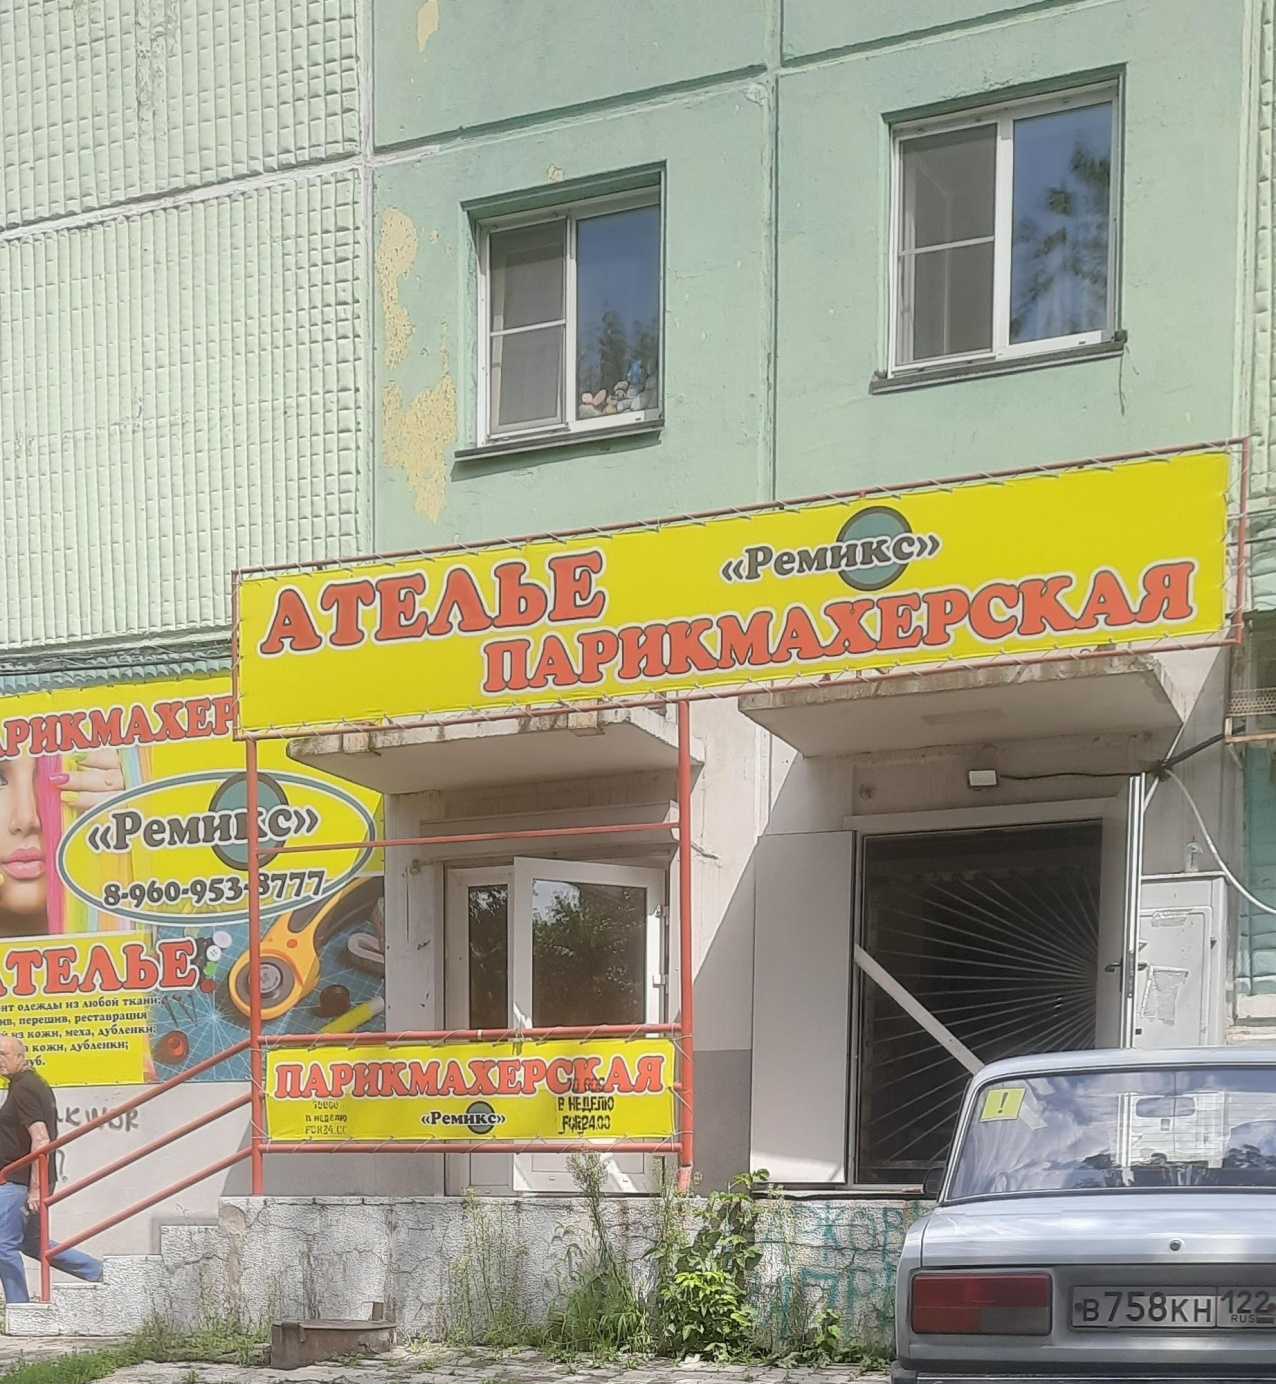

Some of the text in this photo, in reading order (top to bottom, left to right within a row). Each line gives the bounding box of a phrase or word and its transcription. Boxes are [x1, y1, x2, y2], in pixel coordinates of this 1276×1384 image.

[721, 533, 940, 582] «Ремикс»
[260, 550, 606, 655] АТЕЛЬЕ
[483, 562, 1195, 693] ПАРИКМАХЕРСКАЯ
[0, 696, 236, 757] РИКМАХЕР
[103, 870, 326, 908] 8-960-953-8777
[0, 939, 197, 997] ТЕЛЬЕ
[17, 1002, 63, 1012] одежды
[65, 1001, 80, 1009] из
[82, 996, 119, 1008] любой
[75, 1011, 147, 1024] реставрация
[275, 1056, 666, 1098] ПАРИКМАХЕРСКАЯ
[421, 1112, 506, 1127] «Ремикс»
[1083, 1290, 1270, 1322] В758КН 122
[1231, 1314, 1256, 1324] RUS
